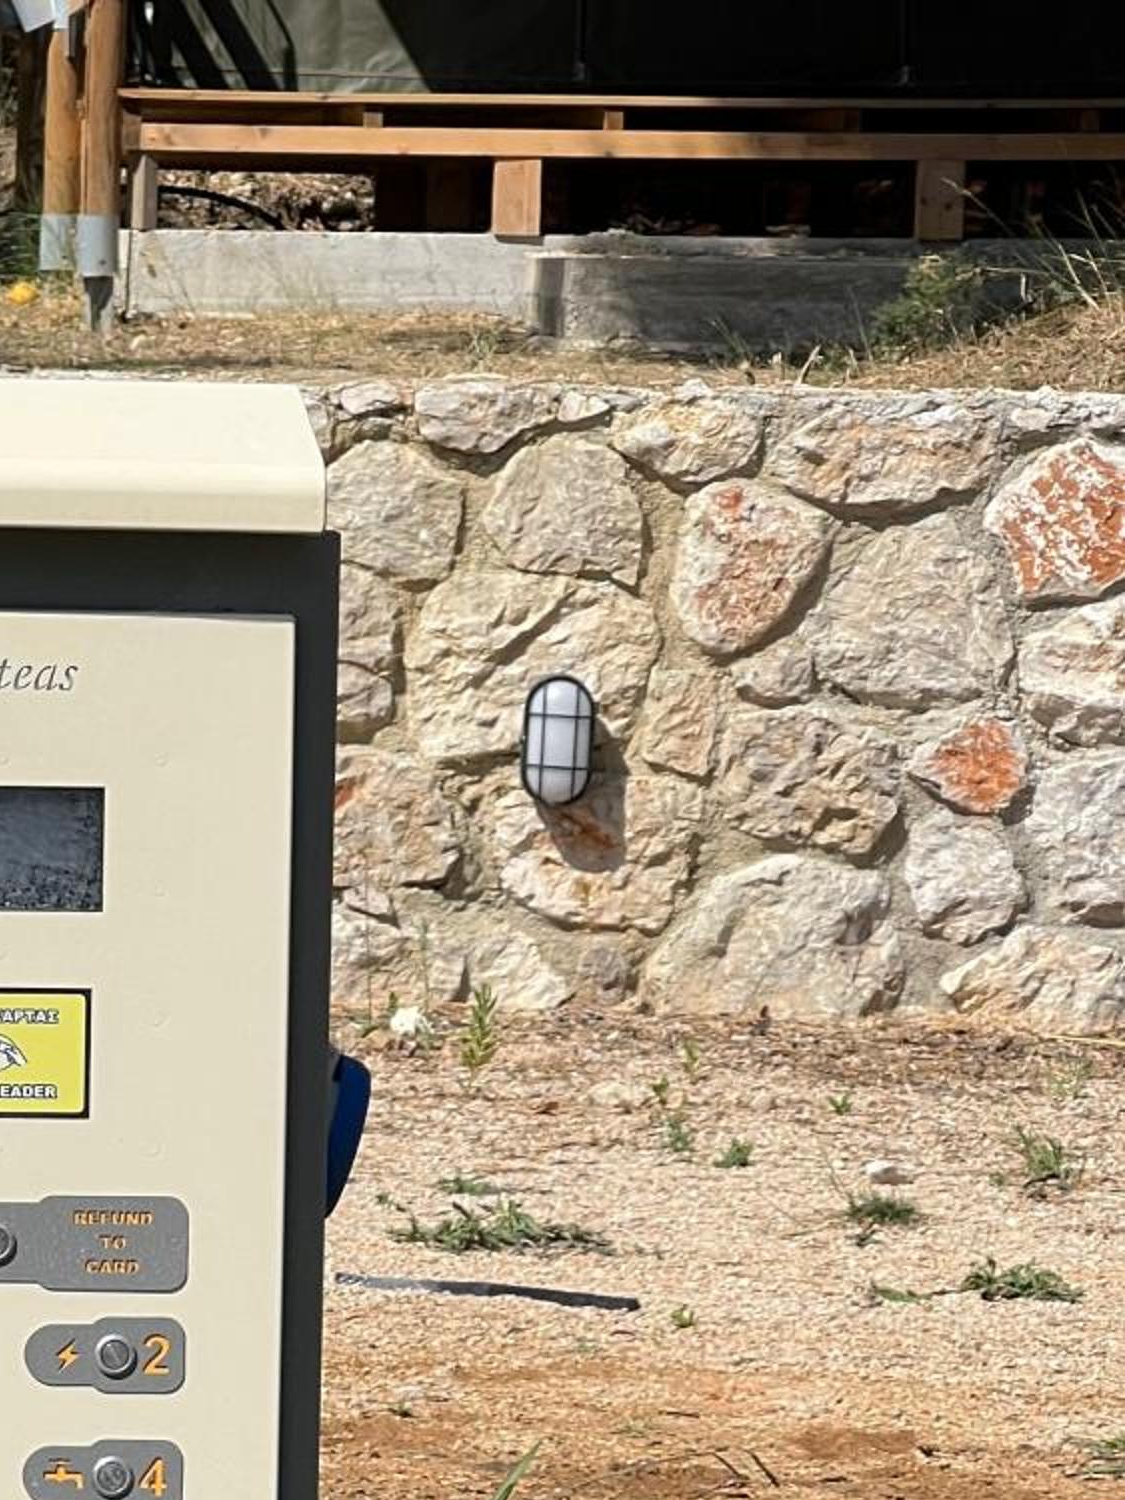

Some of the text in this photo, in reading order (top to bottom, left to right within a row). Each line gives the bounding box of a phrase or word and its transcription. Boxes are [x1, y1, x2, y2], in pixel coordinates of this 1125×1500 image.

[73, 1209, 153, 1225] REFUND
[98, 1233, 127, 1249] TO
[84, 1258, 140, 1274] CARD
[141, 1333, 172, 1376] 2
[138, 1457, 168, 1497] 4
